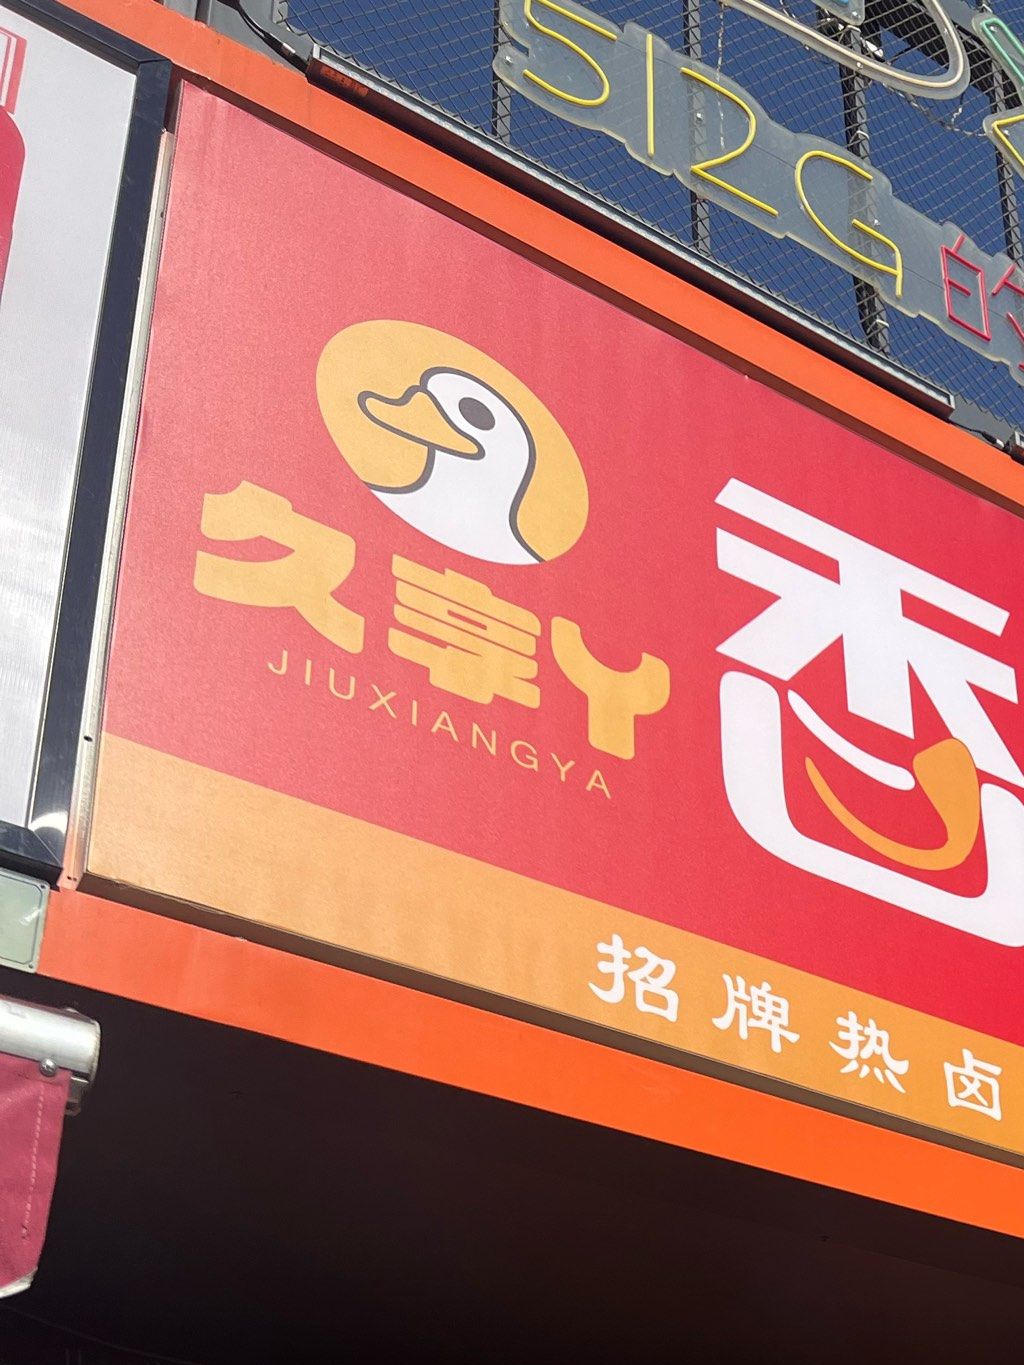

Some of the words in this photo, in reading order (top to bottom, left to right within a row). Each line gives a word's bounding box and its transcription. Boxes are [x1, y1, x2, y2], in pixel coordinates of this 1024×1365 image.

[267, 649, 613, 800] JIUXIANGYA
[589, 934, 1004, 1122] 招牌热卤
